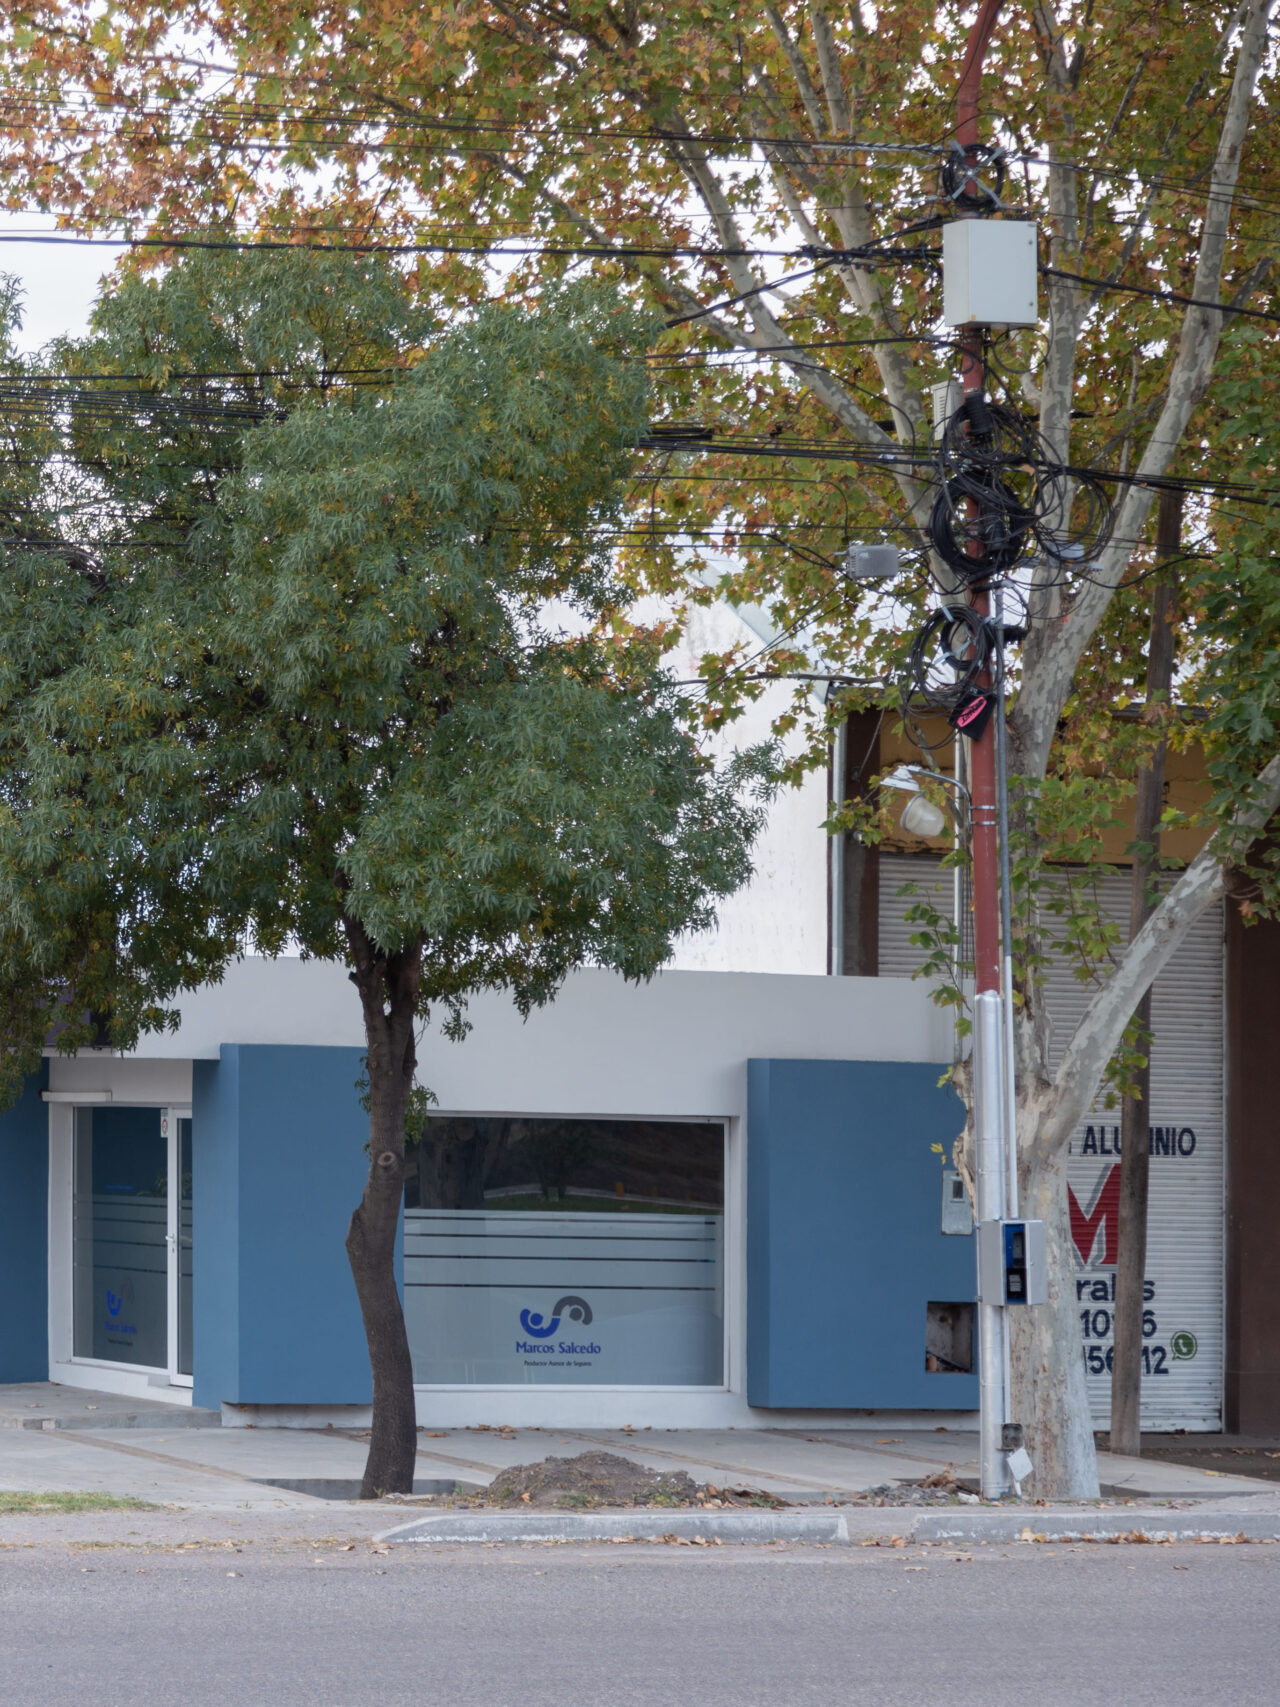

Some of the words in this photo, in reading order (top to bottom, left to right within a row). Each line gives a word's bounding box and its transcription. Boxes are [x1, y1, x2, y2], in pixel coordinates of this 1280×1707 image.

[1081, 1125, 1196, 1156] ALUINIO
[1076, 1272, 1155, 1302] rals
[516, 1341, 555, 1353] Marcos
[558, 1341, 602, 1354] Salcedo
